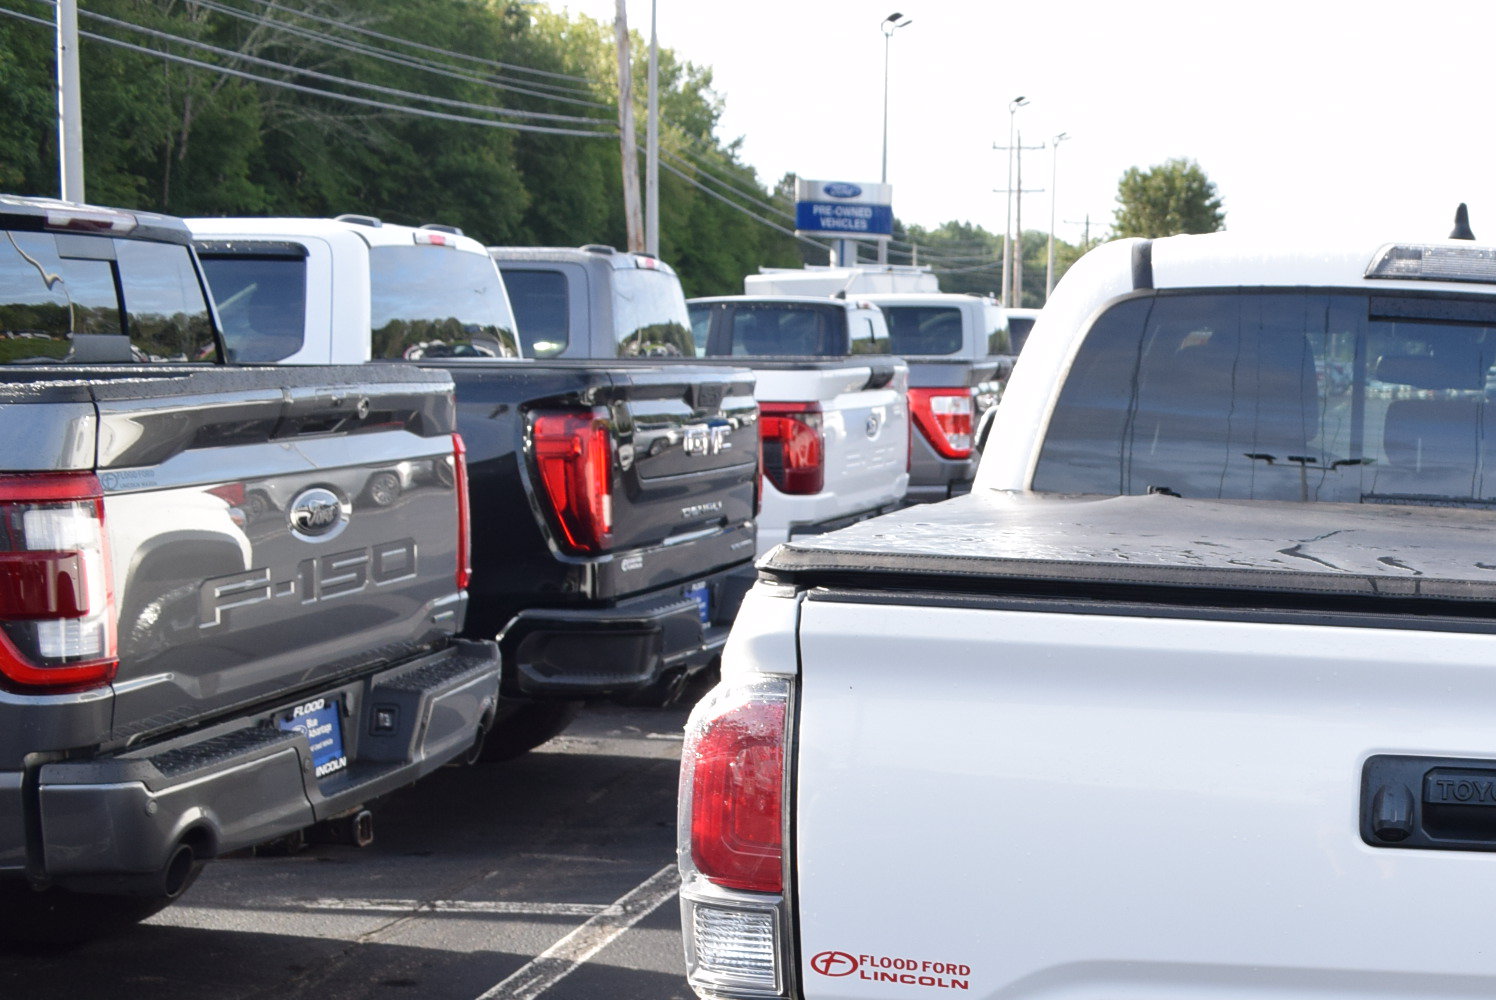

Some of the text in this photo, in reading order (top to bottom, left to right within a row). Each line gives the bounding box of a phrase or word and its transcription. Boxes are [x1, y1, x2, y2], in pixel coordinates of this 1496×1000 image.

[812, 204, 873, 218] PRE-OWNED
[820, 217, 868, 230] VEHICLES
[199, 537, 418, 628] F-150
[293, 698, 325, 718] FLOOD
[315, 756, 347, 777] INCOLN
[859, 954, 971, 976] FLOOD FORD
[859, 970, 969, 990] LINCOLN
